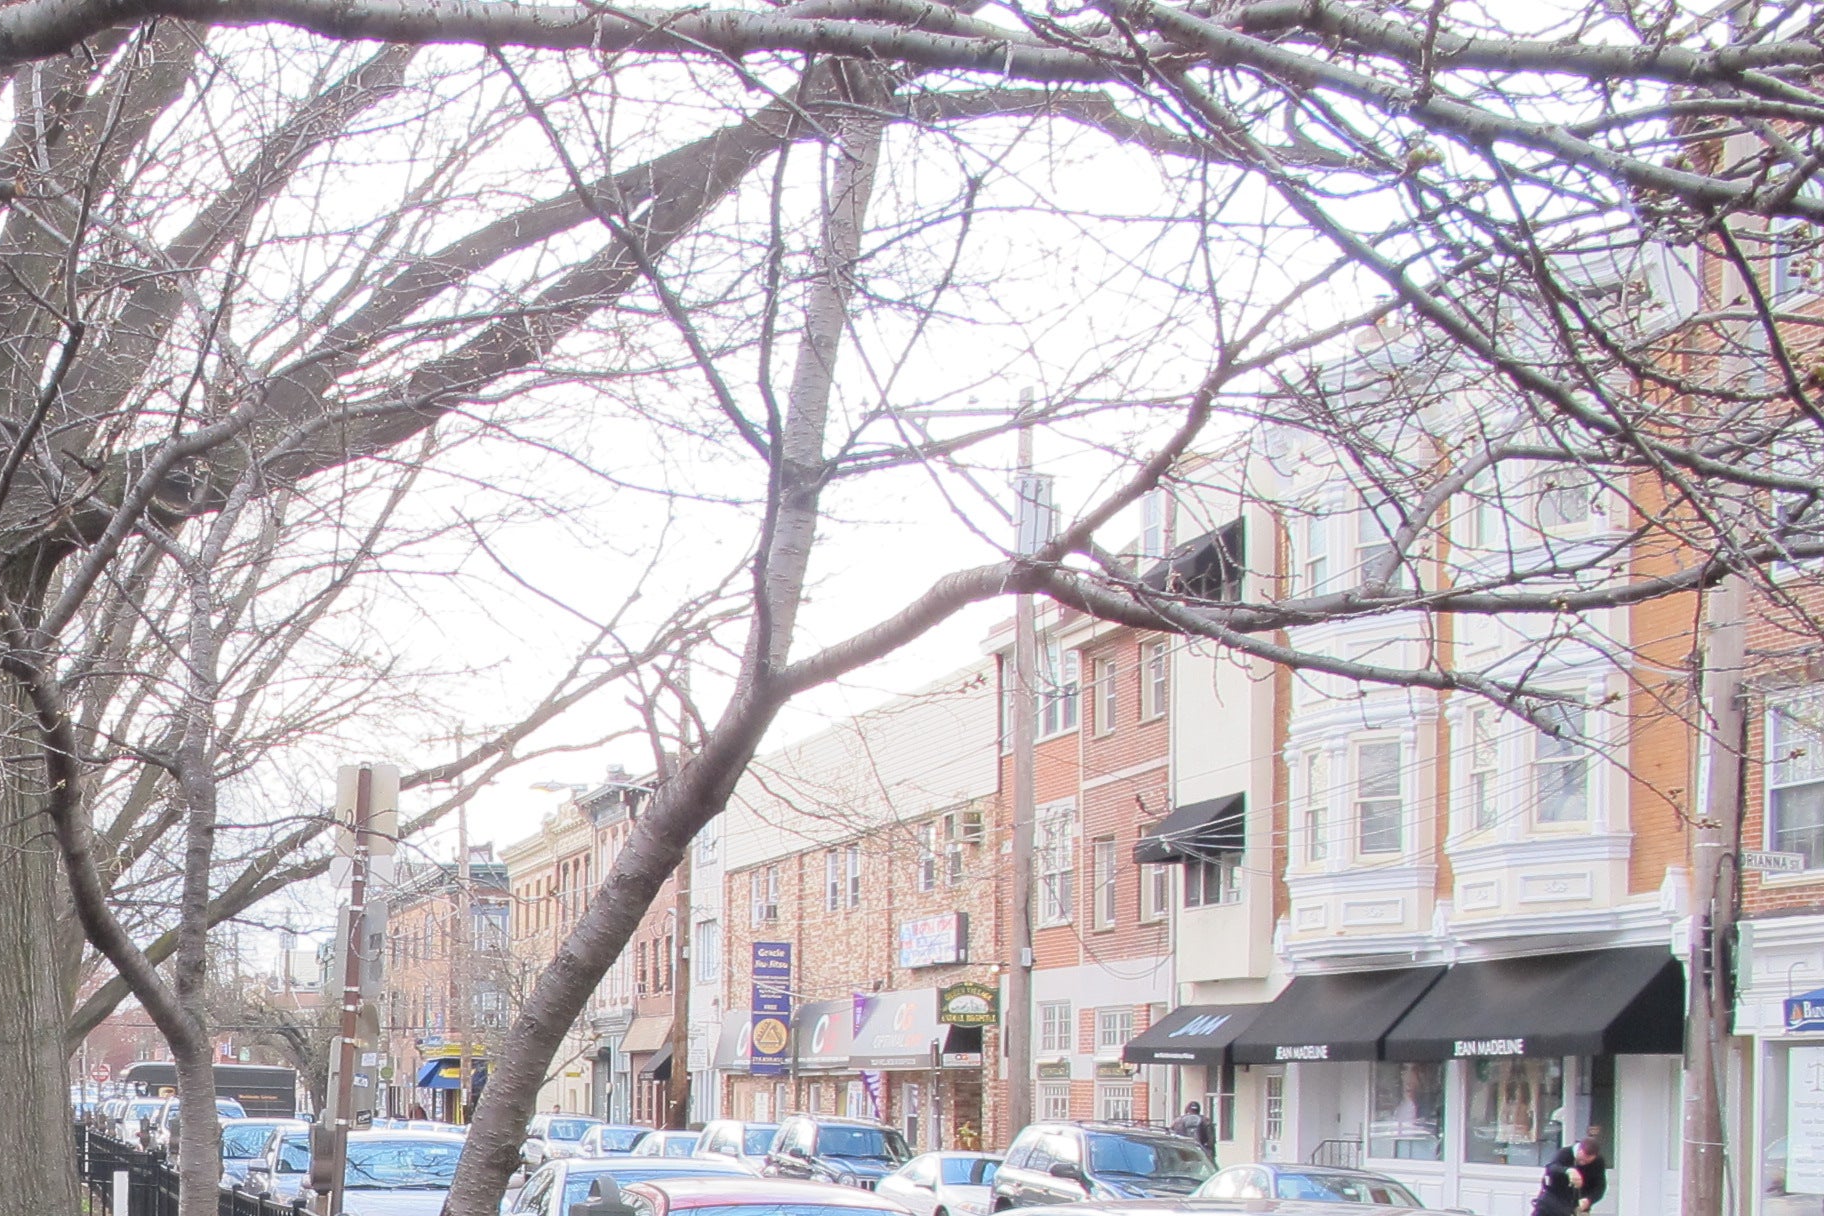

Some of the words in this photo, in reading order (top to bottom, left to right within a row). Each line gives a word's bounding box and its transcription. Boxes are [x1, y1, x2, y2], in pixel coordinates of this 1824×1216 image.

[1275, 1046, 1292, 1060] JEAN
[1293, 1045, 1328, 1059] MADELINE
[1454, 1040, 1476, 1056] JEAN
[1477, 1038, 1524, 1055] MADELINE
